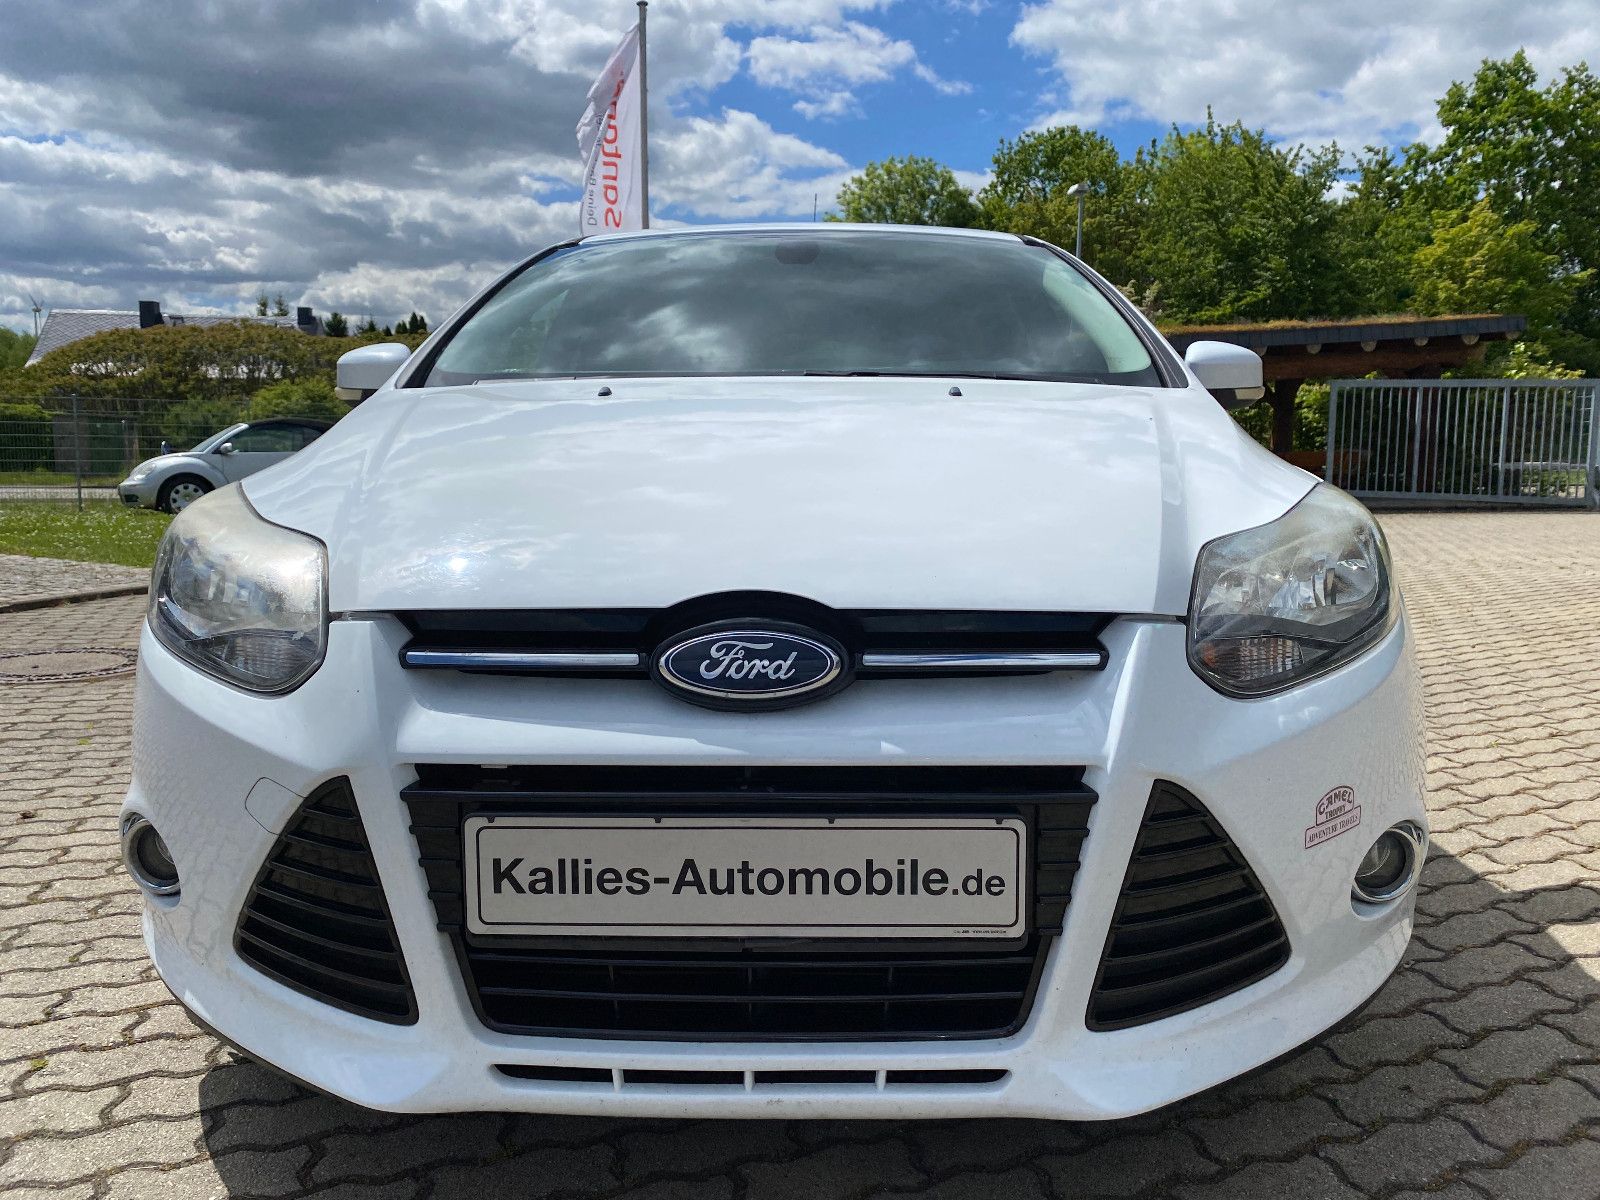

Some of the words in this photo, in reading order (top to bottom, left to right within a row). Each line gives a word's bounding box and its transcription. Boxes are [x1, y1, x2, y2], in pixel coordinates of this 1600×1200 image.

[699, 640, 798, 680] Ford
[1318, 789, 1353, 816] CAMEL
[492, 857, 1006, 896] Kallies-Automobile.de
